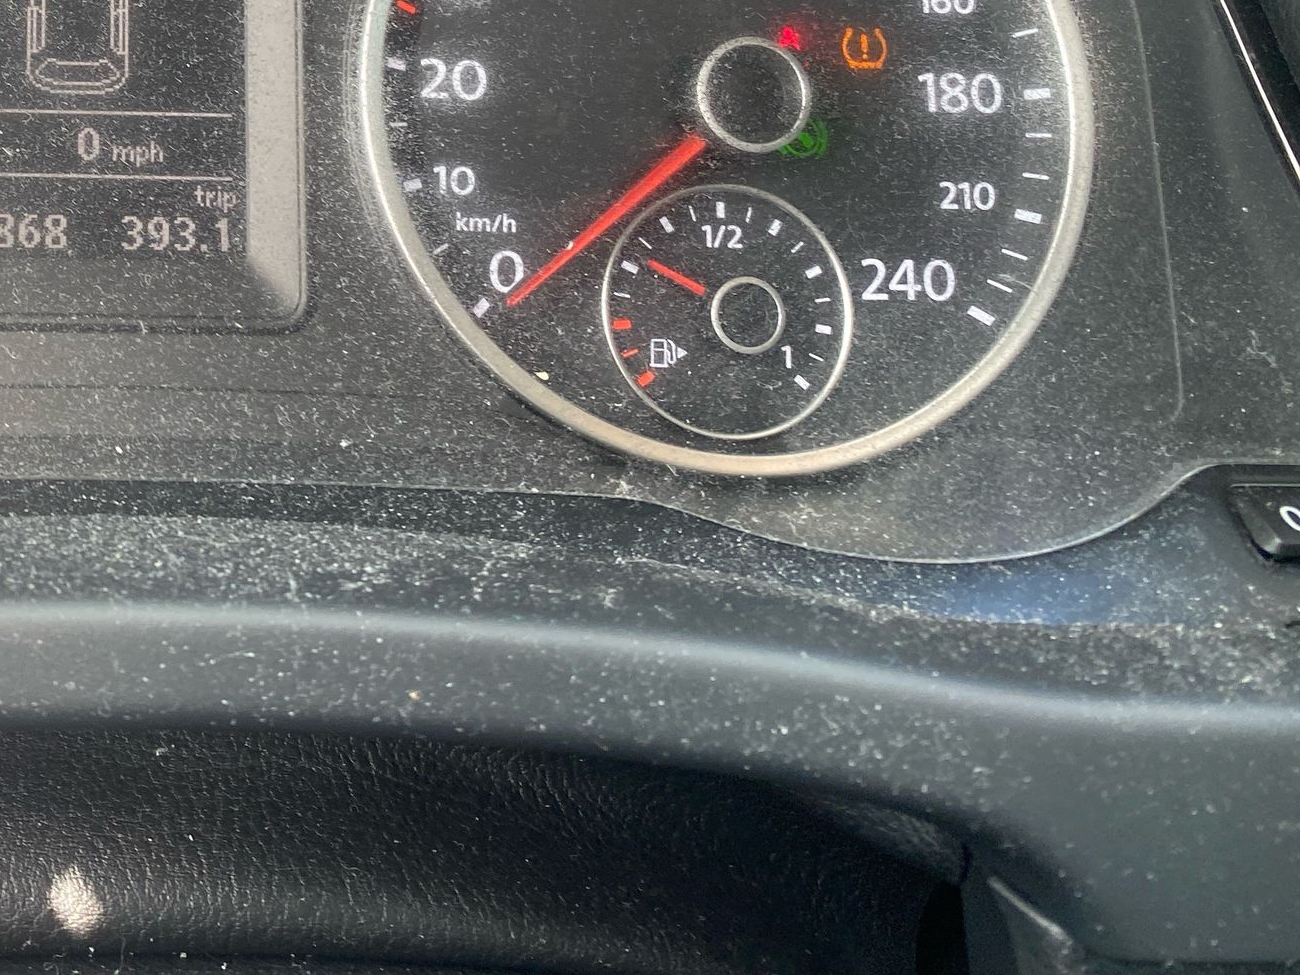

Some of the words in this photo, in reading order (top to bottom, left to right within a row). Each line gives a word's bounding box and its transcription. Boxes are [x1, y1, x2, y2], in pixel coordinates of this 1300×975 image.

[420, 59, 487, 100] 20
[918, 73, 1002, 113] 180
[78, 129, 99, 160] 0
[112, 140, 164, 165] mph
[434, 166, 475, 194] 10
[196, 185, 237, 212] trip
[939, 183, 995, 210] 210
[121, 215, 231, 253] 393.1
[455, 211, 517, 233] km/h
[702, 225, 742, 249] 1/2
[489, 251, 524, 292] 0
[861, 258, 955, 301] 240
[782, 346, 793, 368] 1
